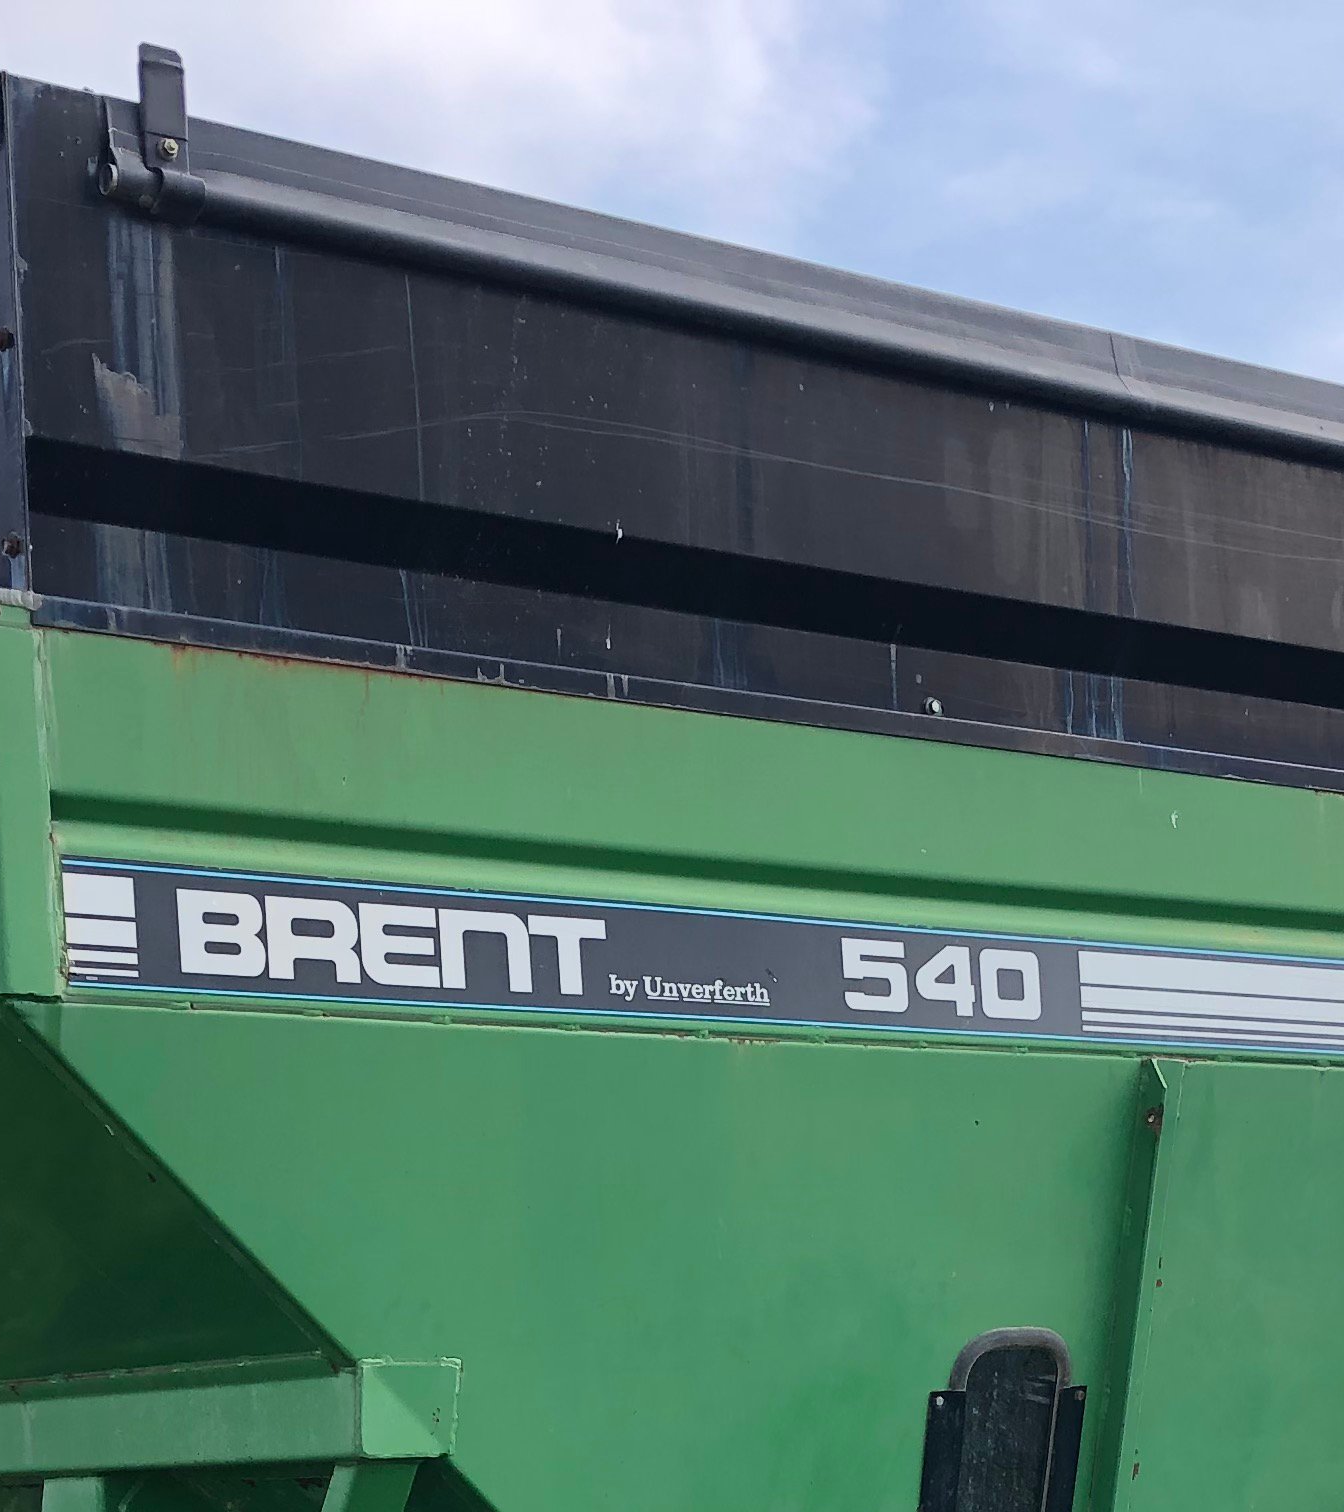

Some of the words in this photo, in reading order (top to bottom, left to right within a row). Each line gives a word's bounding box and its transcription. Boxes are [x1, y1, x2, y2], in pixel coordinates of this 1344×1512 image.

[176, 889, 606, 995] BRENT
[609, 974, 638, 1000] by
[643, 976, 770, 1005] Unverferth
[841, 937, 1042, 1021] 540
